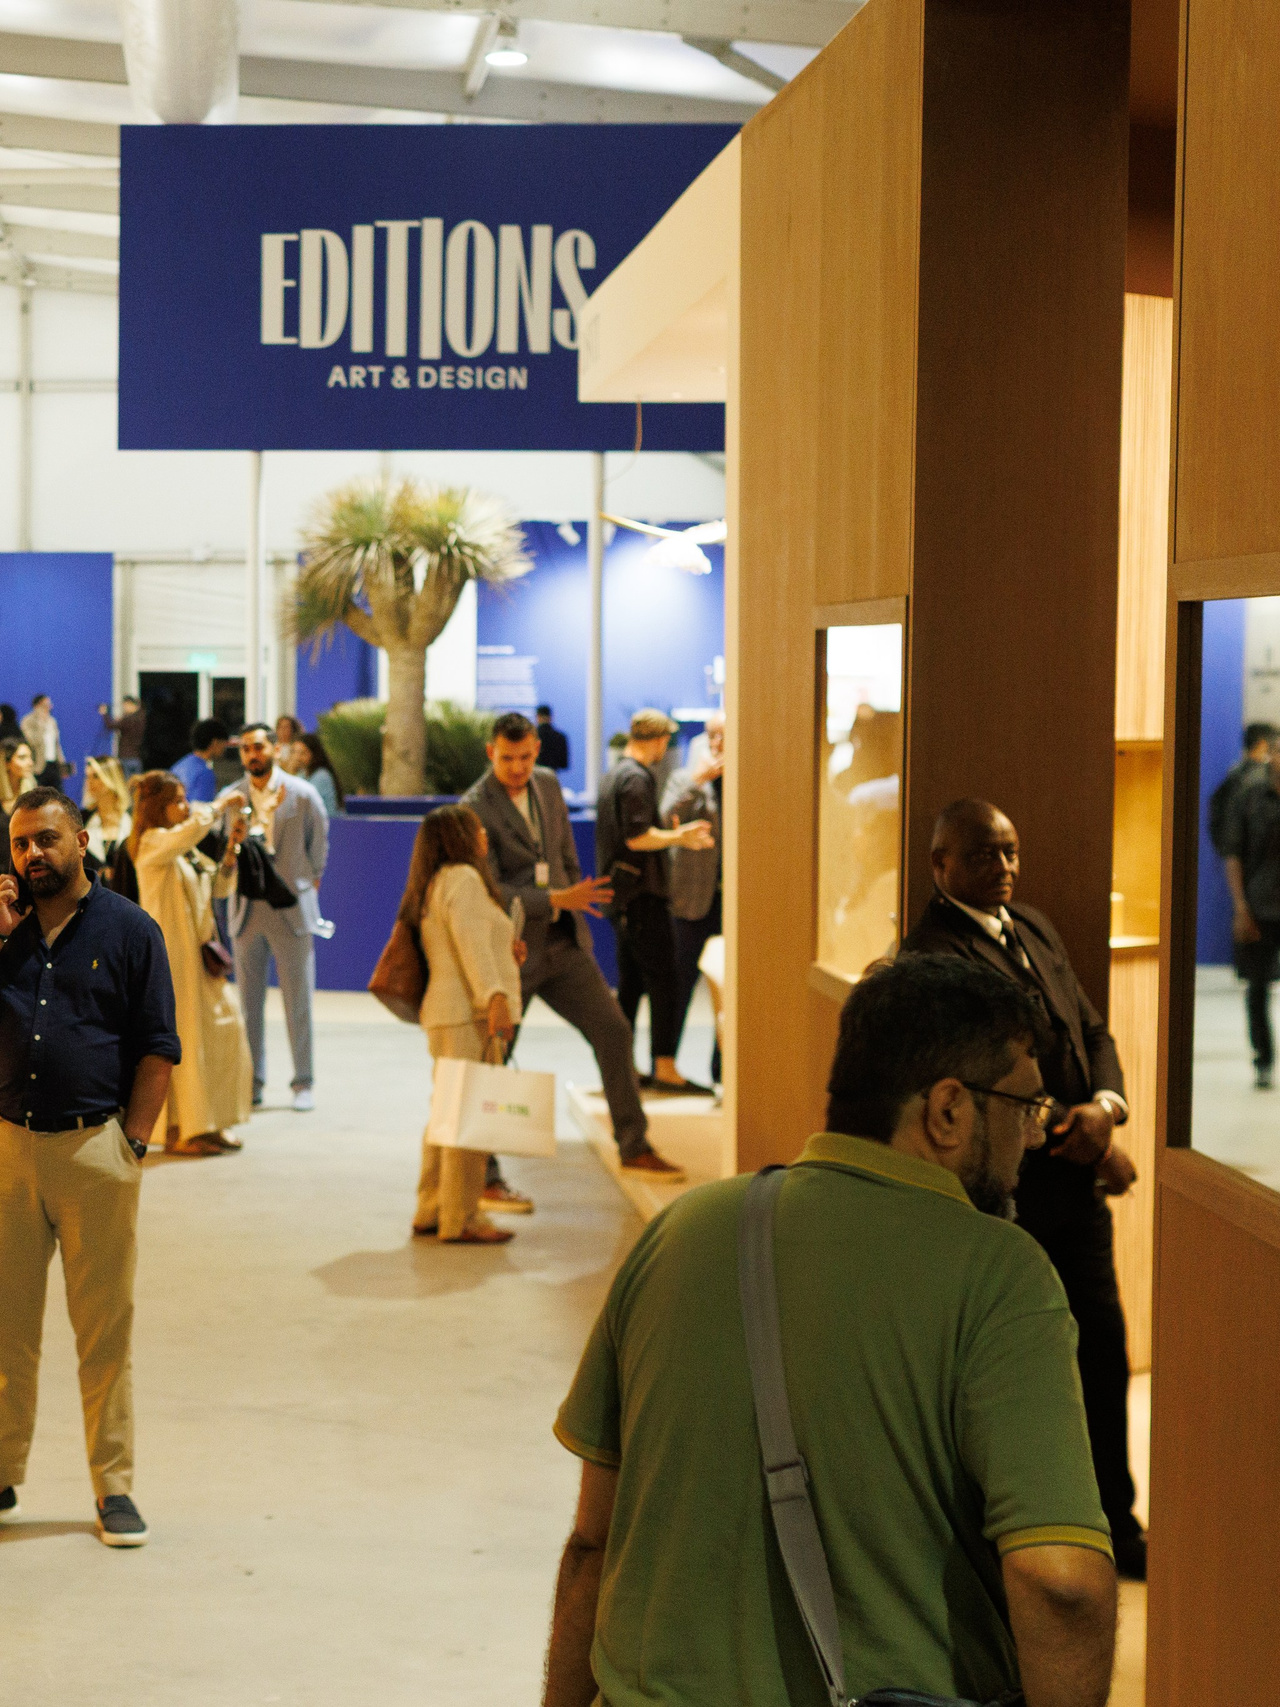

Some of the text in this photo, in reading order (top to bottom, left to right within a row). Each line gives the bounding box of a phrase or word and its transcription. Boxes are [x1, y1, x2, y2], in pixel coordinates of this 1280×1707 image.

[261, 217, 597, 360] EDITIONS
[328, 365, 528, 390] ART & DESIGN
